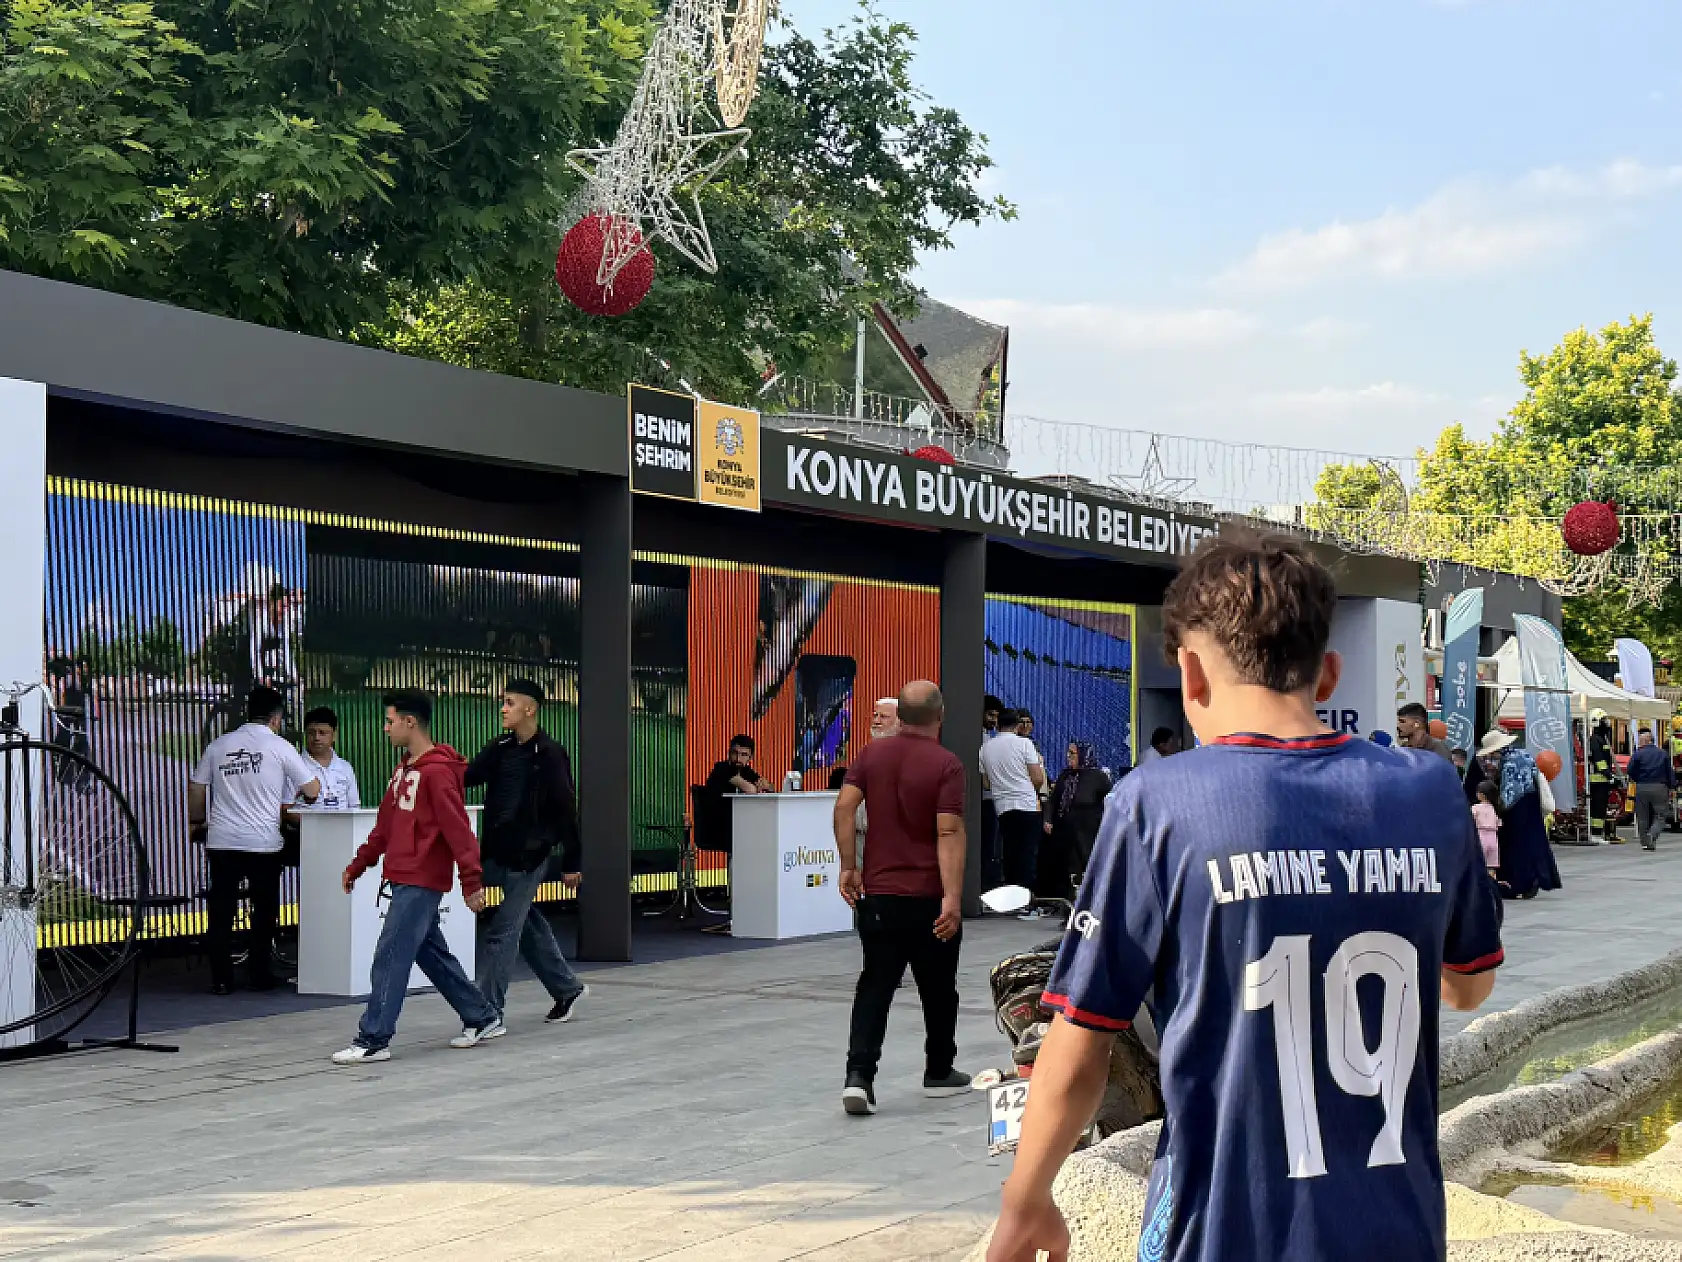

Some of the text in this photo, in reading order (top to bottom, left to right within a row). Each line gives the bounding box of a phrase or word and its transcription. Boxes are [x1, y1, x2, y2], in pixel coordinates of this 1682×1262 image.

[634, 412, 691, 446] BENİM
[635, 443, 691, 472] ŞEHRİM
[786, 444, 1219, 556] KONYA BÜYÜKŞEHİR BELEDİYE
[1207, 847, 1441, 904] LAMINE YAMAL
[1243, 930, 1421, 1178] 19
[995, 1086, 1027, 1112] 42
